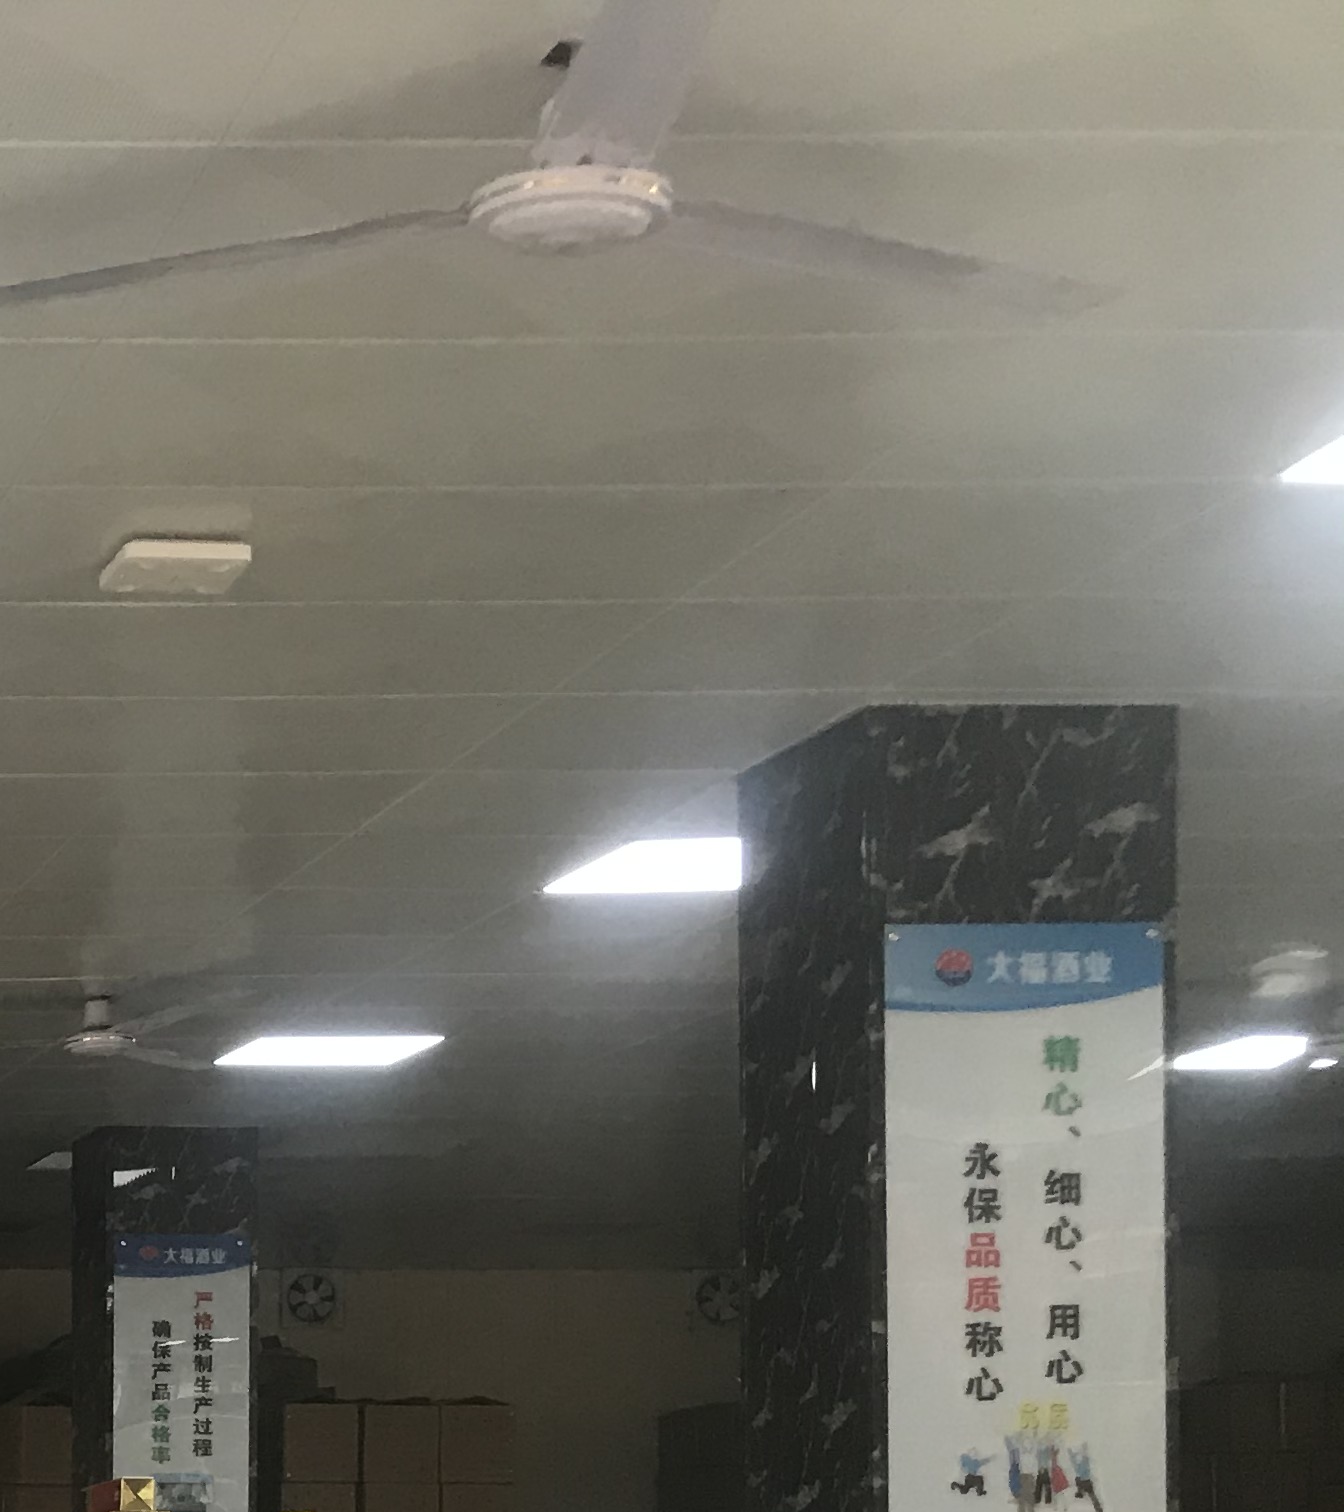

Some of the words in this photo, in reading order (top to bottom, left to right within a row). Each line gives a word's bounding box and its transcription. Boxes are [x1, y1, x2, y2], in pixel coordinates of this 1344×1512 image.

[986, 950, 1113, 985] 大福酒业
[963, 1142, 1003, 1403] 永保品质称心
[1041, 1035, 1085, 1386] 精心、细心、用心
